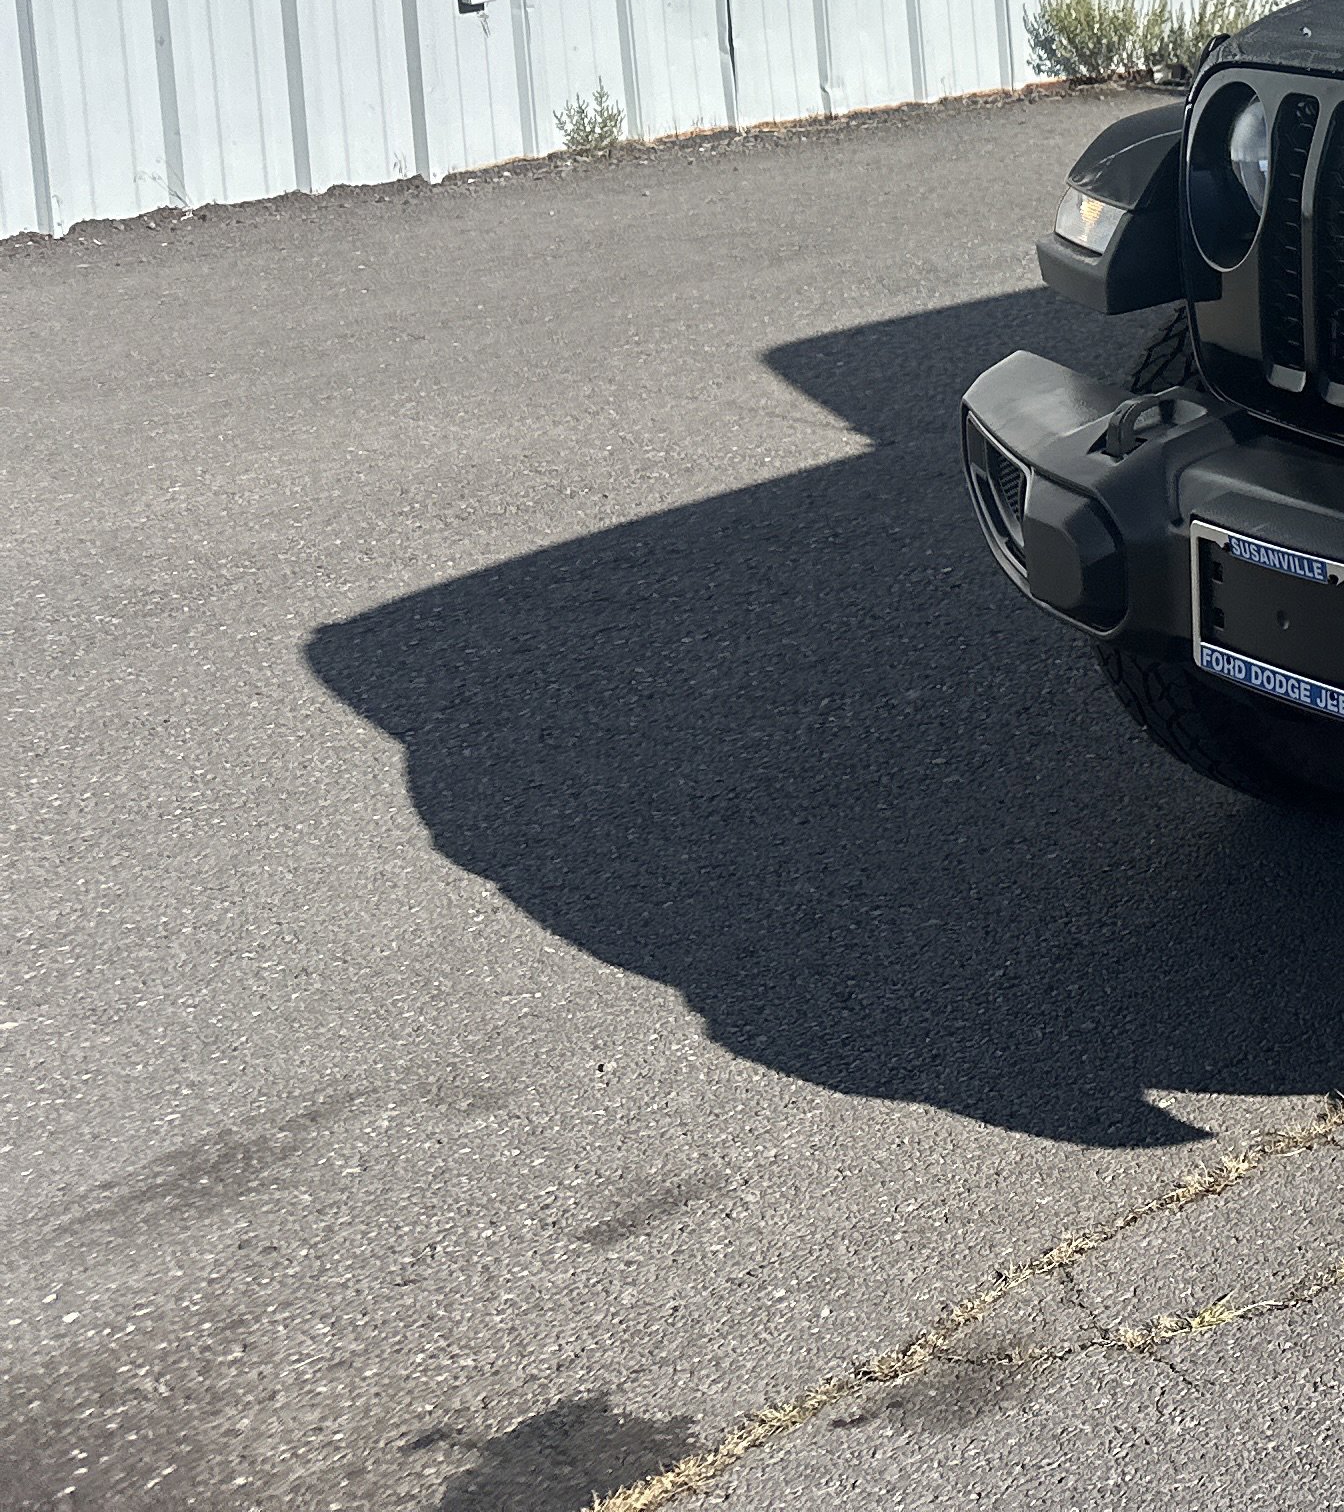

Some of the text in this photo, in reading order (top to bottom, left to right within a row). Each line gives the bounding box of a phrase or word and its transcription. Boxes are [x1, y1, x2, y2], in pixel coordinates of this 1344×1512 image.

[1231, 538, 1324, 580] SUSANVILLE
[1202, 647, 1246, 679] FORD
[1251, 665, 1311, 703] DODGE
